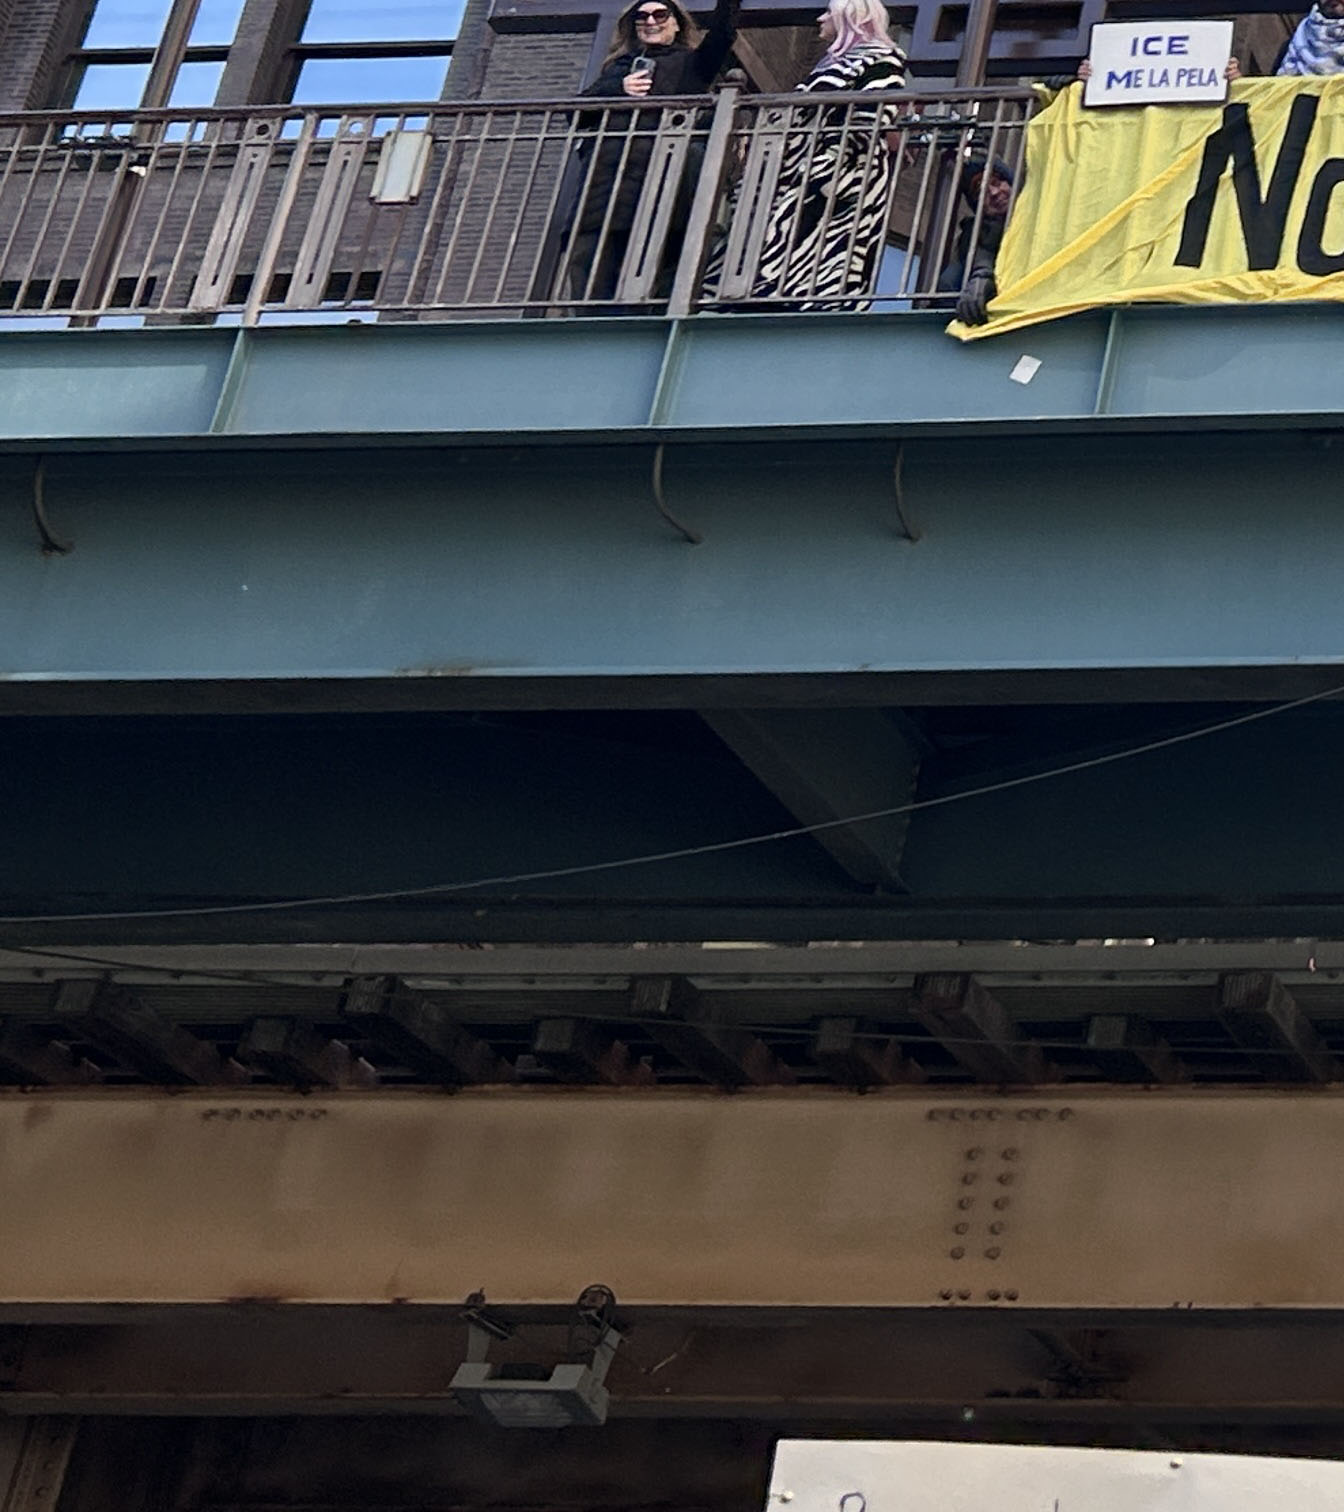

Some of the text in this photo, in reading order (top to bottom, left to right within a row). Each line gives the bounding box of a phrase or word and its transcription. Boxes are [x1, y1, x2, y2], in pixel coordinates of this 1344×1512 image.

[1130, 35, 1190, 57] ICE
[1105, 67, 1219, 91] ME LA PELA
